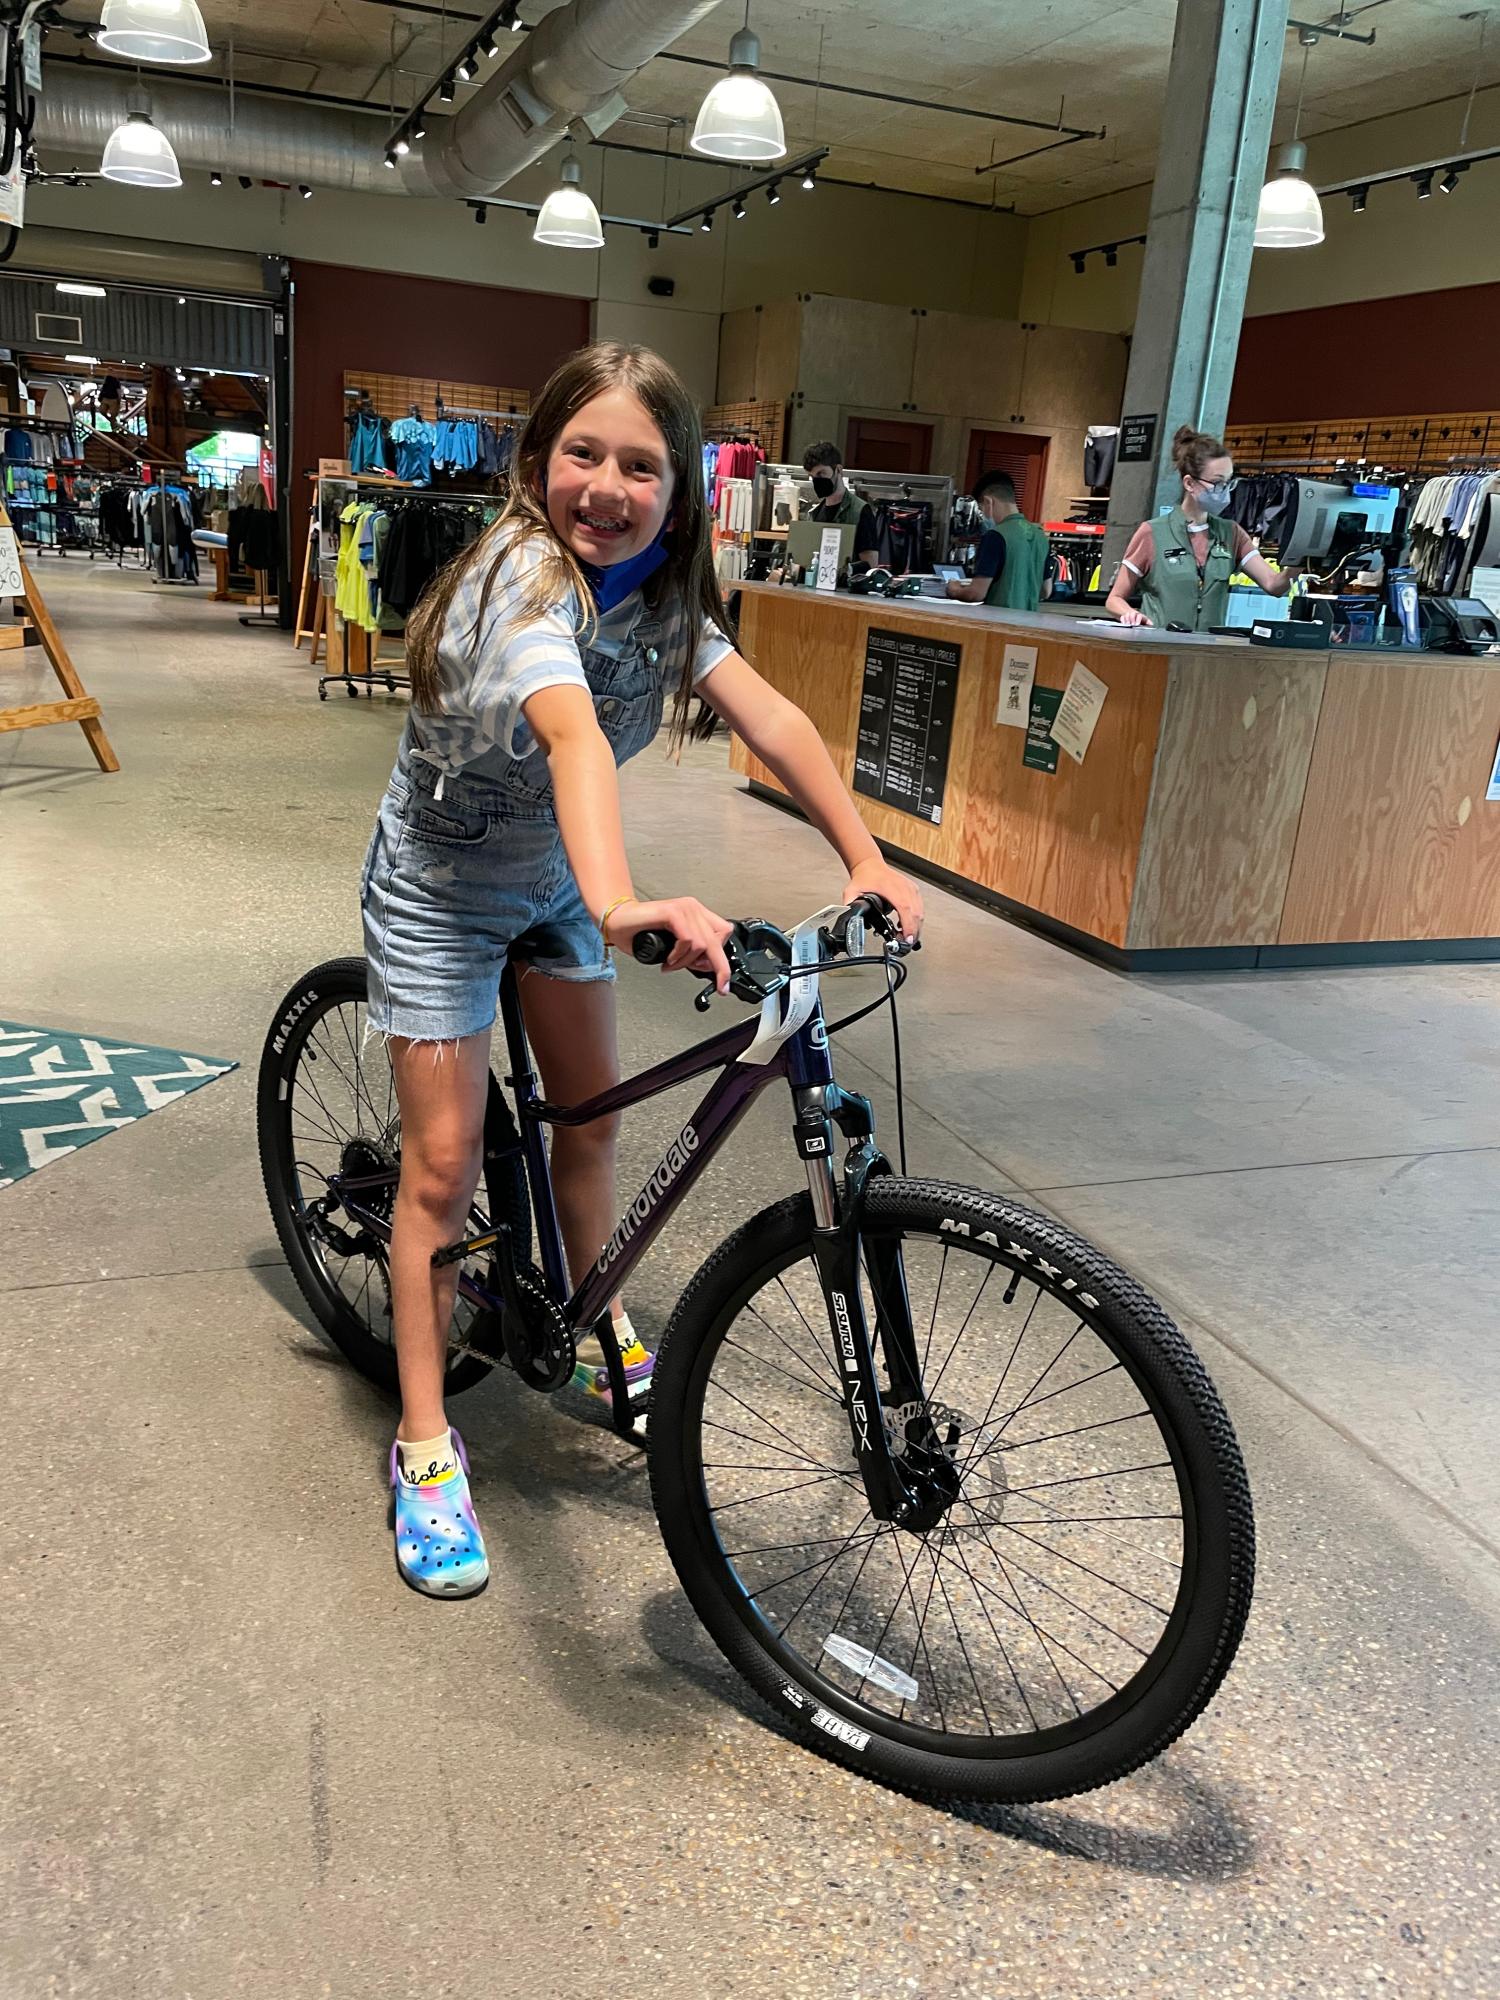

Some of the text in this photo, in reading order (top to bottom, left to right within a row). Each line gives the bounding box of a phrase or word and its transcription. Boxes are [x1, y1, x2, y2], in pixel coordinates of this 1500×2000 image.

[272, 990, 319, 1054] MAXXIS
[597, 1125, 700, 1274] cannondale
[939, 1218, 1100, 1310] MAXXIS
[810, 1708, 872, 1752] PACE
